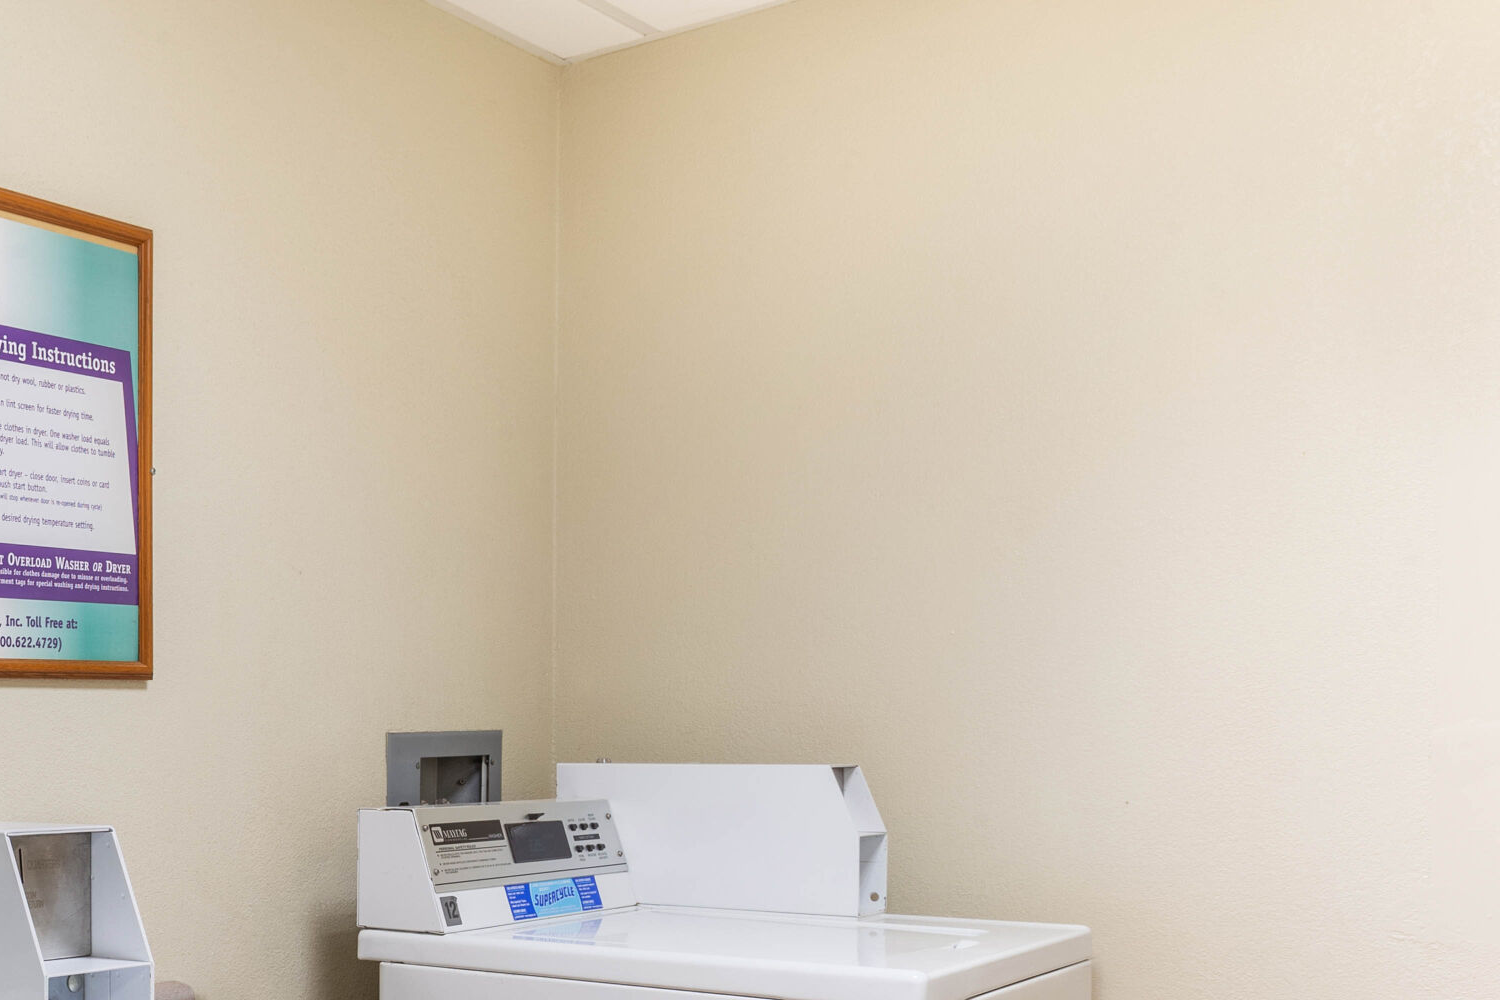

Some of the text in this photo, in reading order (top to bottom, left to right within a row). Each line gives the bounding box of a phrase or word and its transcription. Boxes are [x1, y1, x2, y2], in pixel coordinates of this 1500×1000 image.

[32, 342, 116, 374] Instructions
[0, 374, 10, 382] not
[12, 374, 21, 385] dry
[22, 377, 37, 387] wool,
[39, 380, 57, 389] rubber
[65, 384, 86, 395] plastics.
[6, 399, 17, 409] lint
[18, 403, 36, 411] screen
[37, 404, 45, 413] for
[46, 405, 62, 416] faster
[63, 409, 80, 421] drying
[81, 412, 94, 421] time.
[4, 423, 25, 434] clothes
[26, 426, 32, 434] in
[33, 427, 49, 438] dryer.
[50, 429, 61, 439] One
[62, 433, 80, 441] washer
[81, 434, 93, 444] load
[94, 437, 111, 446] equals
[9, 469, 23, 480] dryer
[30, 472, 44, 481] close
[61, 475, 76, 485] insert
[77, 478, 91, 487] coins
[99, 481, 110, 489] card
[2, 513, 22, 523] desired
[23, 515, 41, 527] drying
[42, 518, 74, 528] temperature
[75, 521, 95, 532] setting.
[8, 552, 52, 568] OVERLOAD
[56, 556, 90, 571] WASHER
[93, 562, 103, 572] OR
[106, 560, 131, 574] DRYER
[6, 615, 23, 627] Inc.
[26, 616, 42, 628] Toll
[45, 617, 64, 629] Free
[67, 619, 78, 630] at:
[534, 886, 575, 906] SUPERCYCLE
[444, 901, 460, 920] 12
